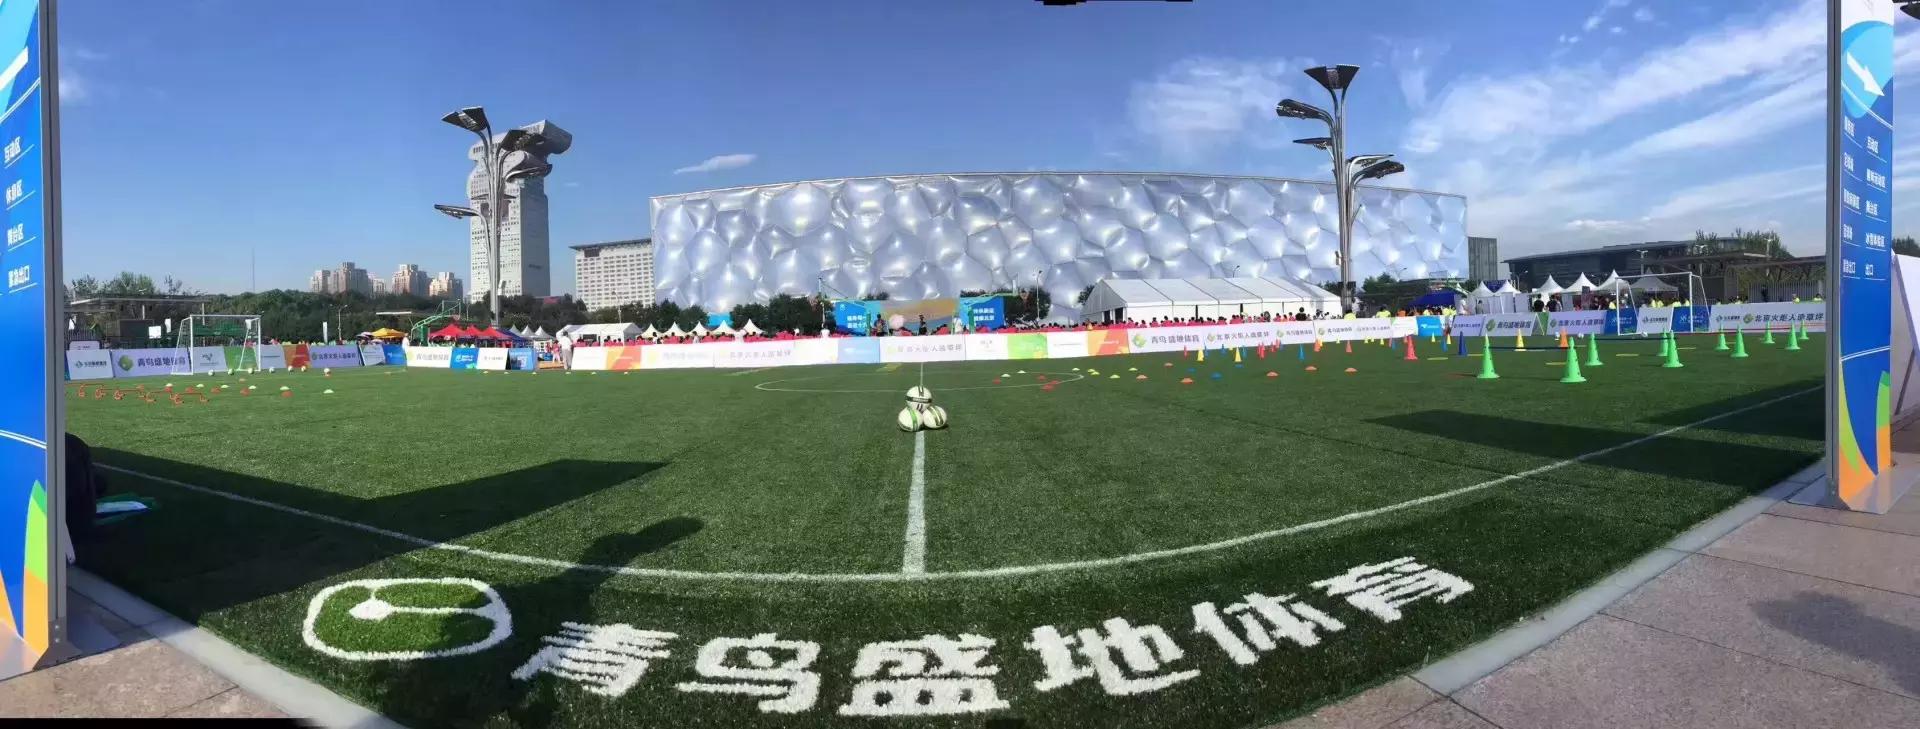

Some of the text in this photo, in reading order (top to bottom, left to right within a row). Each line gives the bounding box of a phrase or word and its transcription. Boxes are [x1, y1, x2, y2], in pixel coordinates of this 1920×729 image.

[1755, 312, 1825, 322] 北京火炬人造草坪
[510, 556, 1474, 717] 青鸟盛地体育
